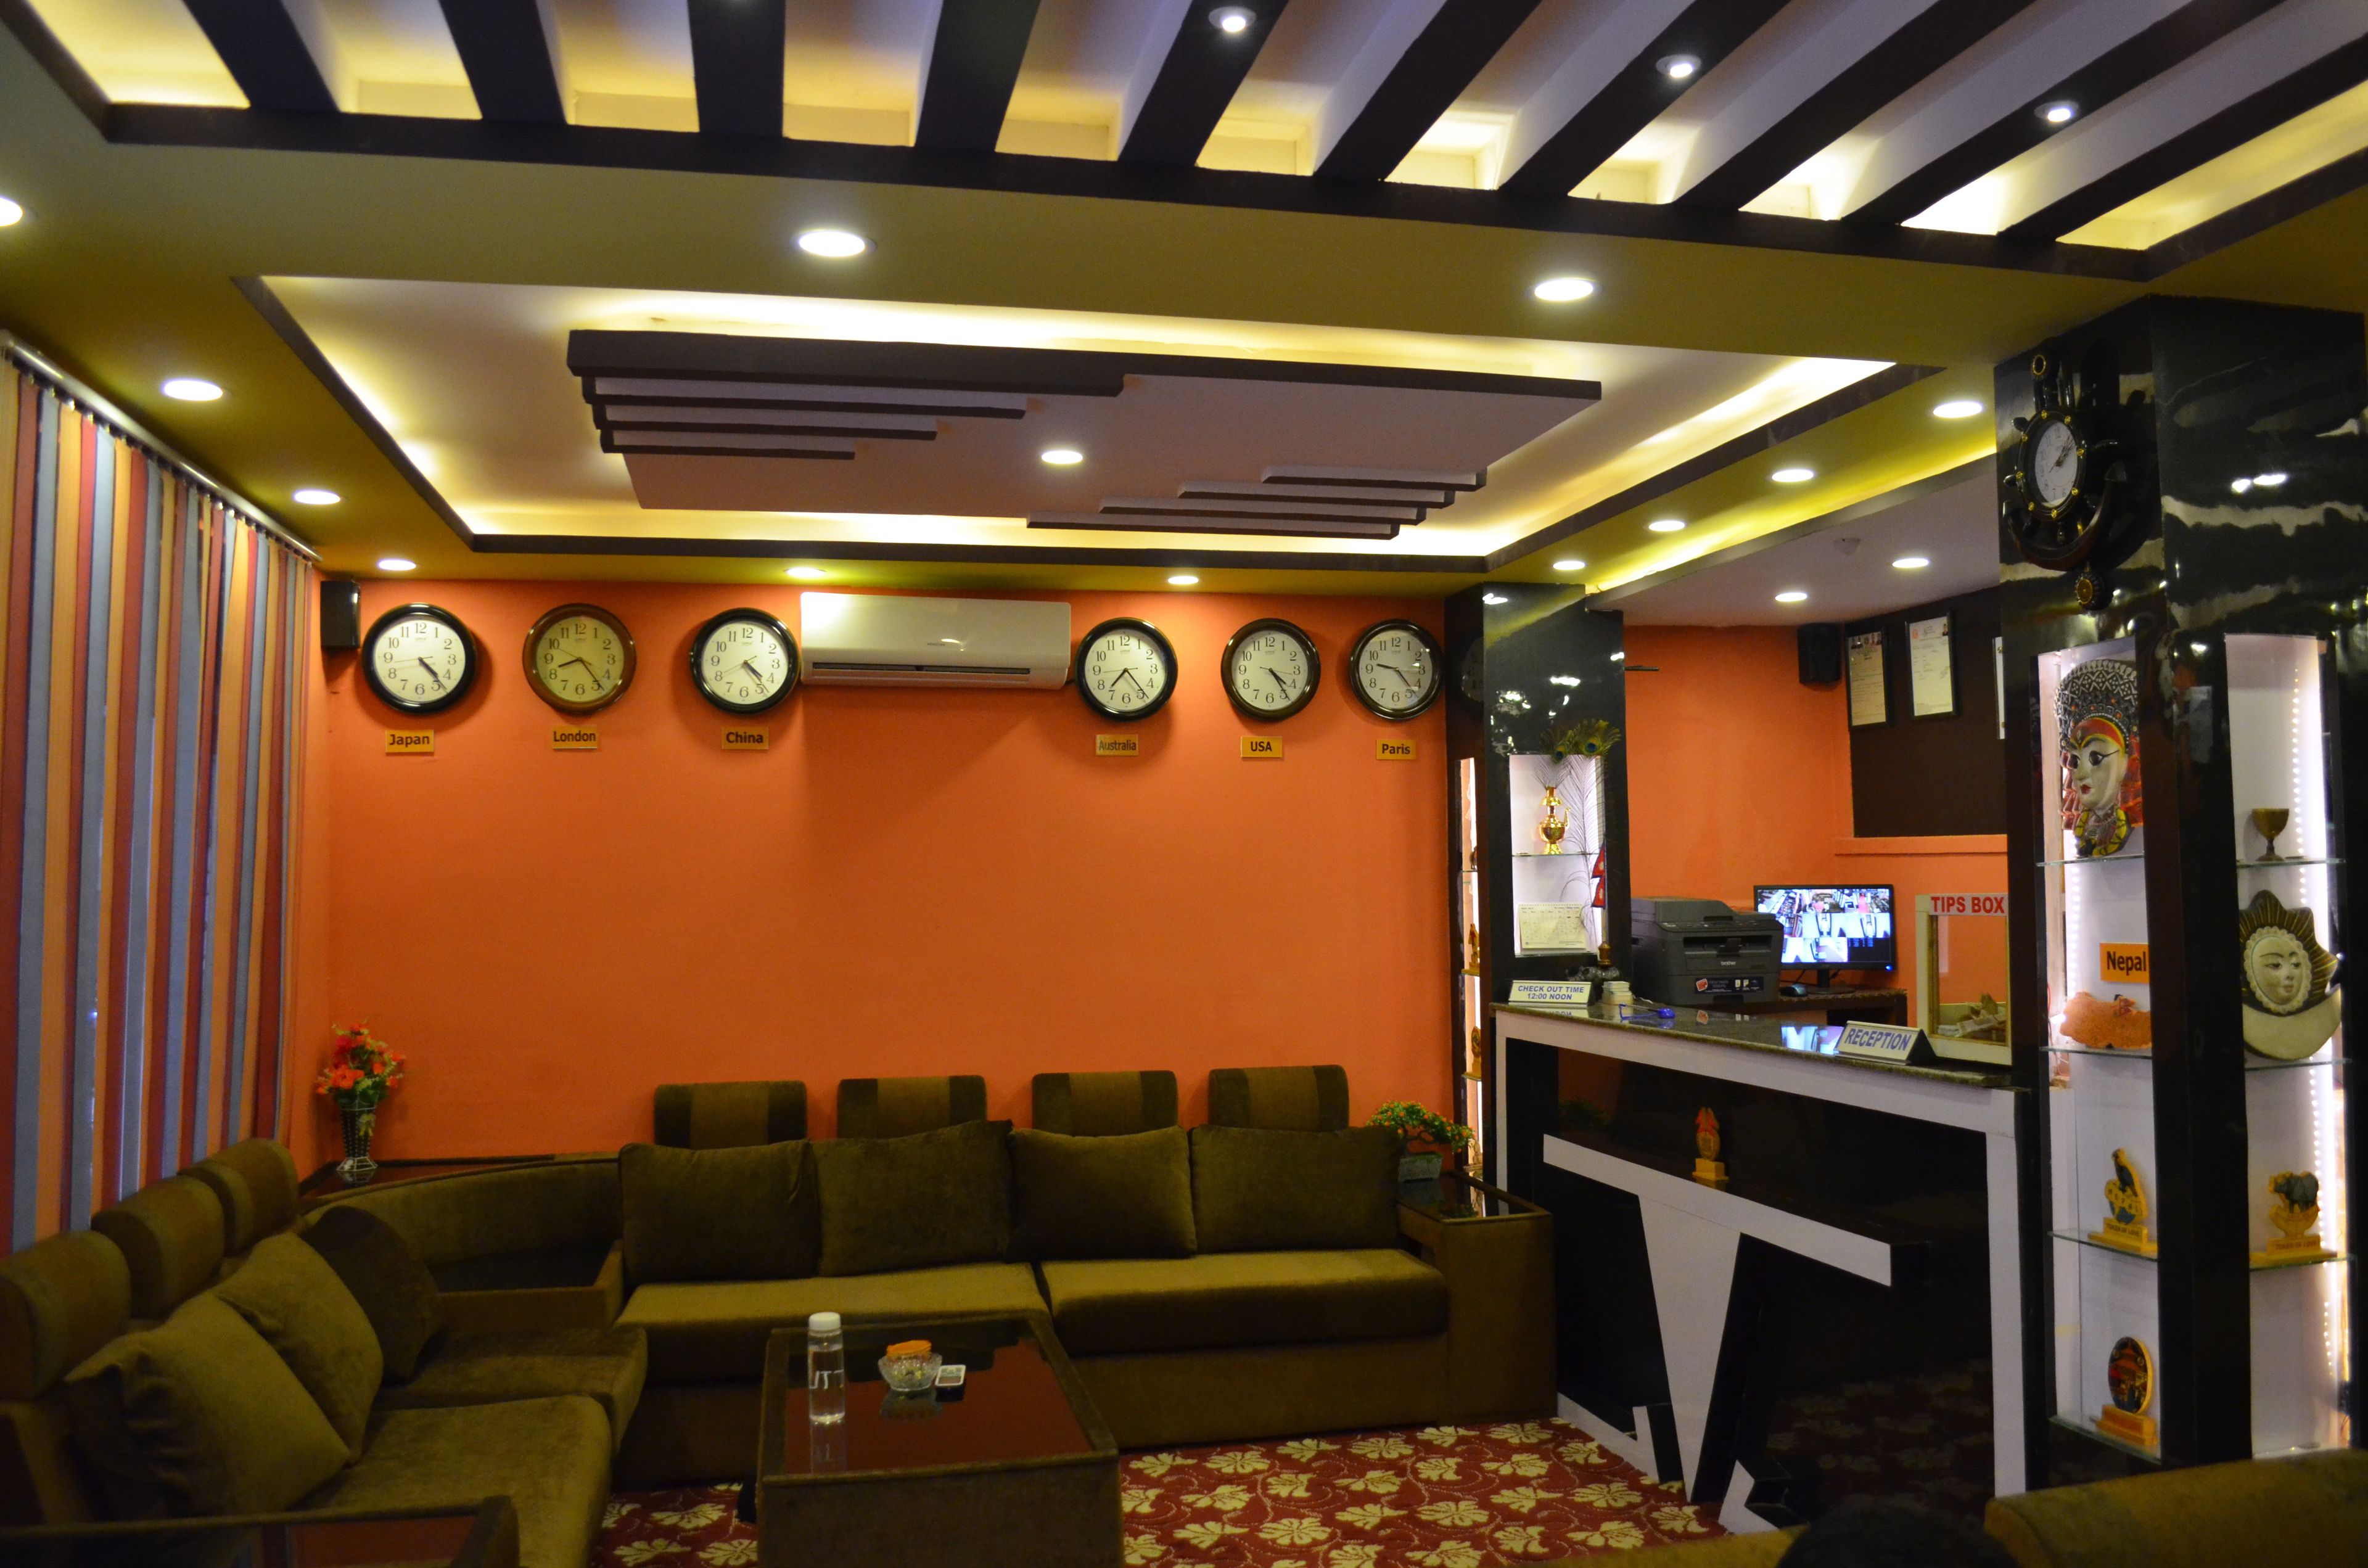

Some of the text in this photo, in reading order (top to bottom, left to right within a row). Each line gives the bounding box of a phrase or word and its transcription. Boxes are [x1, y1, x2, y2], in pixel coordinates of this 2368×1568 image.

[401, 626, 409, 638] 11
[416, 622, 427, 633] 12
[434, 627, 438, 638] 1
[561, 627, 569, 638] 11
[575, 623, 586, 634] 12
[593, 628, 598, 638] 1
[729, 631, 736, 641] 11
[743, 628, 753, 638] 12
[760, 632, 764, 642] 1
[389, 638, 399, 648] 10
[444, 639, 452, 649] 2
[549, 638, 559, 649] 10
[603, 639, 610, 649] 2
[1108, 640, 1114, 650] 11
[1120, 636, 1130, 646] 12
[1137, 639, 1141, 649] 1
[1254, 641, 1260, 651] 11
[1265, 636, 1275, 647] 12
[1281, 641, 1285, 651] 1
[1380, 641, 1386, 651] 11
[1392, 637, 1400, 647] 12
[1407, 641, 1410, 651] 1
[717, 641, 726, 652] 10
[769, 643, 776, 654] 2
[384, 652, 393, 663] 9
[545, 653, 553, 664] 9
[1097, 651, 1106, 661] 10
[1146, 649, 1153, 659] 2
[1243, 651, 1251, 661] 10
[1290, 651, 1296, 661] 2
[1370, 651, 1378, 660] 10
[1415, 651, 1421, 661] 2
[448, 654, 456, 665] 3
[607, 654, 615, 665] 3
[711, 655, 720, 666] 9
[772, 659, 779, 669] 3
[388, 668, 396, 679] 8
[549, 668, 557, 679] 8
[602, 668, 610, 679] 4
[1093, 665, 1101, 675] 9
[1151, 663, 1157, 674] 3
[1239, 665, 1246, 675] 9
[1294, 665, 1301, 675] 3
[1366, 664, 1373, 674] 9
[1419, 665, 1425, 675] 3
[443, 669, 451, 679] 4
[715, 671, 722, 681] 8
[767, 673, 774, 683] 4
[401, 679, 408, 690] 7
[432, 680, 440, 691] 5
[561, 679, 568, 691] 7
[591, 680, 600, 691] 5
[726, 682, 733, 692] 7
[1098, 679, 1104, 690] 8
[1146, 678, 1153, 688] 4
[1243, 679, 1249, 689] 8
[1289, 679, 1296, 689] 4
[1370, 678, 1376, 688] 8
[1414, 678, 1421, 688] 4
[415, 683, 424, 695] 6
[575, 684, 585, 695] 6
[740, 686, 749, 698] 6
[755, 684, 763, 694] 5
[1137, 689, 1145, 699] 5
[1253, 689, 1259, 699] 7
[1280, 689, 1287, 699] 5
[1379, 688, 1386, 698] 7
[1405, 689, 1412, 698] 5
[1109, 690, 1115, 700] 7
[1122, 693, 1130, 704] 6
[1266, 693, 1274, 704] 6
[1392, 692, 1400, 702] 6
[389, 734, 429, 747] Japan
[554, 731, 596, 742] London
[726, 732, 763, 743] China
[1099, 740, 1137, 750] Australia
[1251, 741, 1272, 752] USA
[1382, 744, 1410, 754] Paris
[1931, 897, 2004, 913] TIPS BOX
[2107, 951, 2146, 976] Nepal
[1844, 1028, 1912, 1051] RECEPTION
